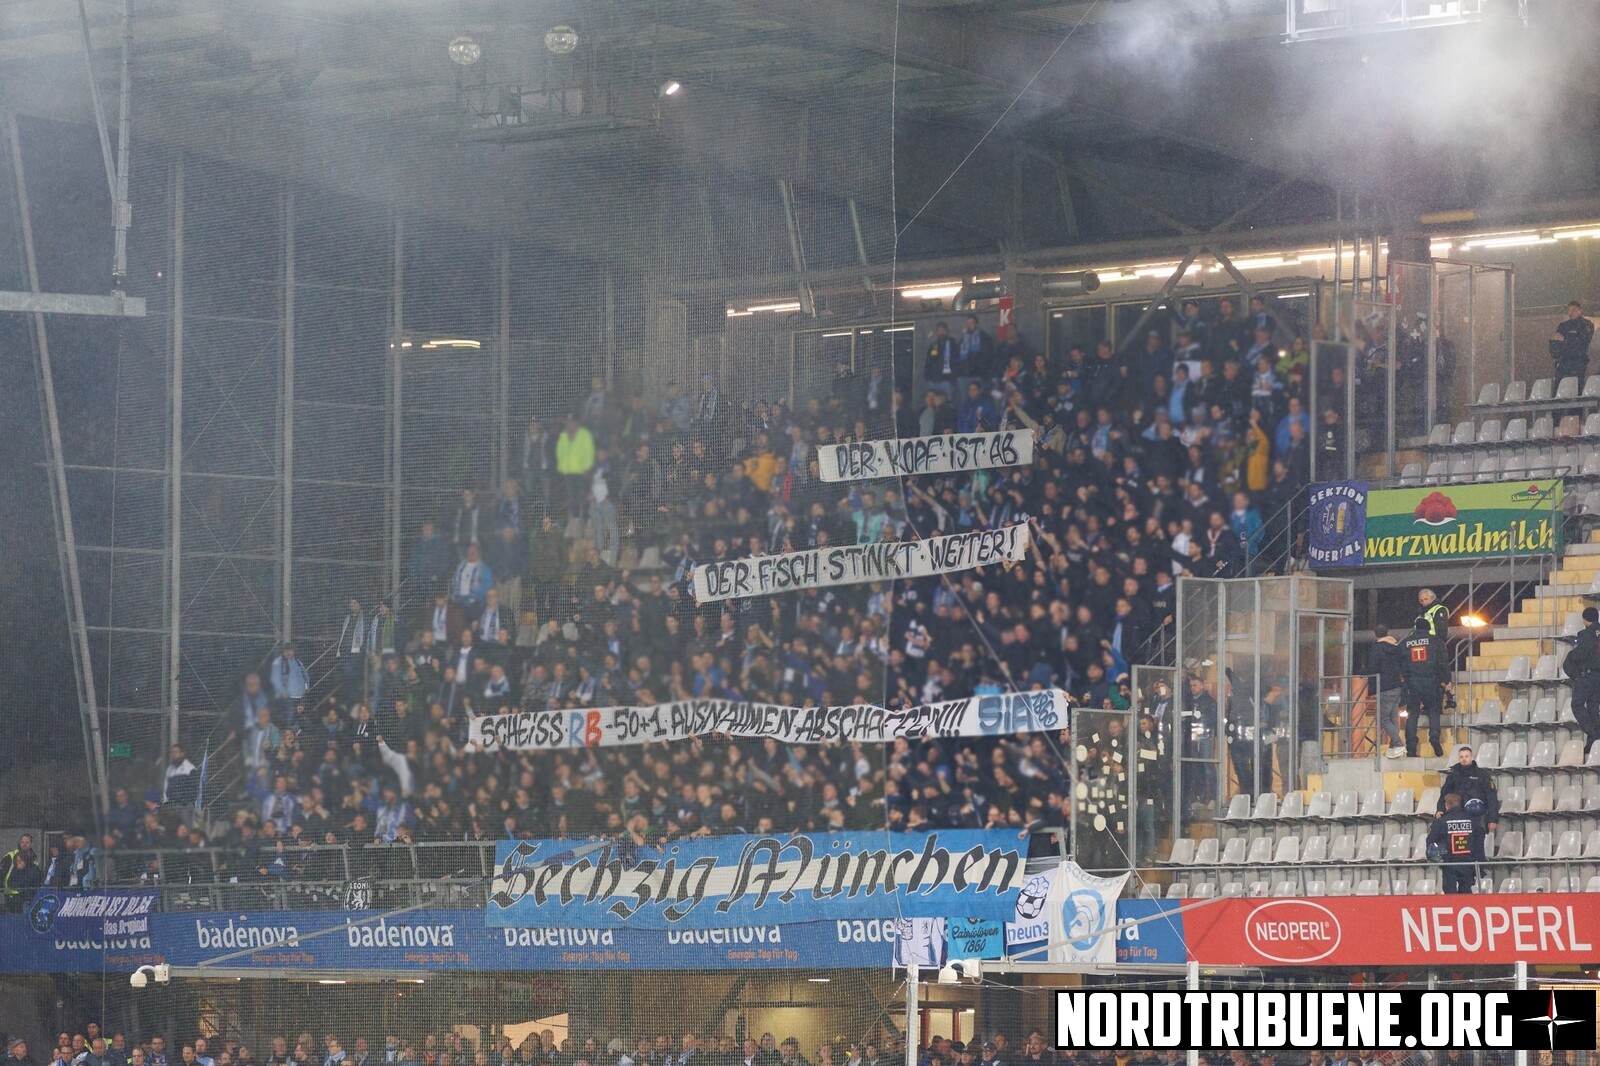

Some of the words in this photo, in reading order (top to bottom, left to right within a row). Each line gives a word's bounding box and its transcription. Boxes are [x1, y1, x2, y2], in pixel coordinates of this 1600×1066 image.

[836, 444, 877, 478] DER
[884, 438, 943, 474] KOPF
[990, 432, 1019, 465] AB
[1310, 486, 1365, 505] SEKTION
[1308, 540, 1361, 561] IMPERIAL
[704, 561, 751, 597] DER
[1406, 638, 1429, 648] POLIZEI
[671, 698, 796, 736] AUSNAHMEN
[1447, 822, 1472, 831] POLIZEI
[489, 840, 719, 922] Sechzig
[714, 832, 1020, 915] München
[57, 893, 107, 917] MÜNCHEN
[105, 896, 127, 916] IST
[196, 918, 300, 948] badenova
[346, 917, 455, 947] badenova
[836, 917, 895, 943] bade
[1401, 905, 1592, 952] NEOPERL
[963, 939, 987, 953] 1860
[1129, 946, 1141, 958] für
[1142, 946, 1158, 959] Tag
